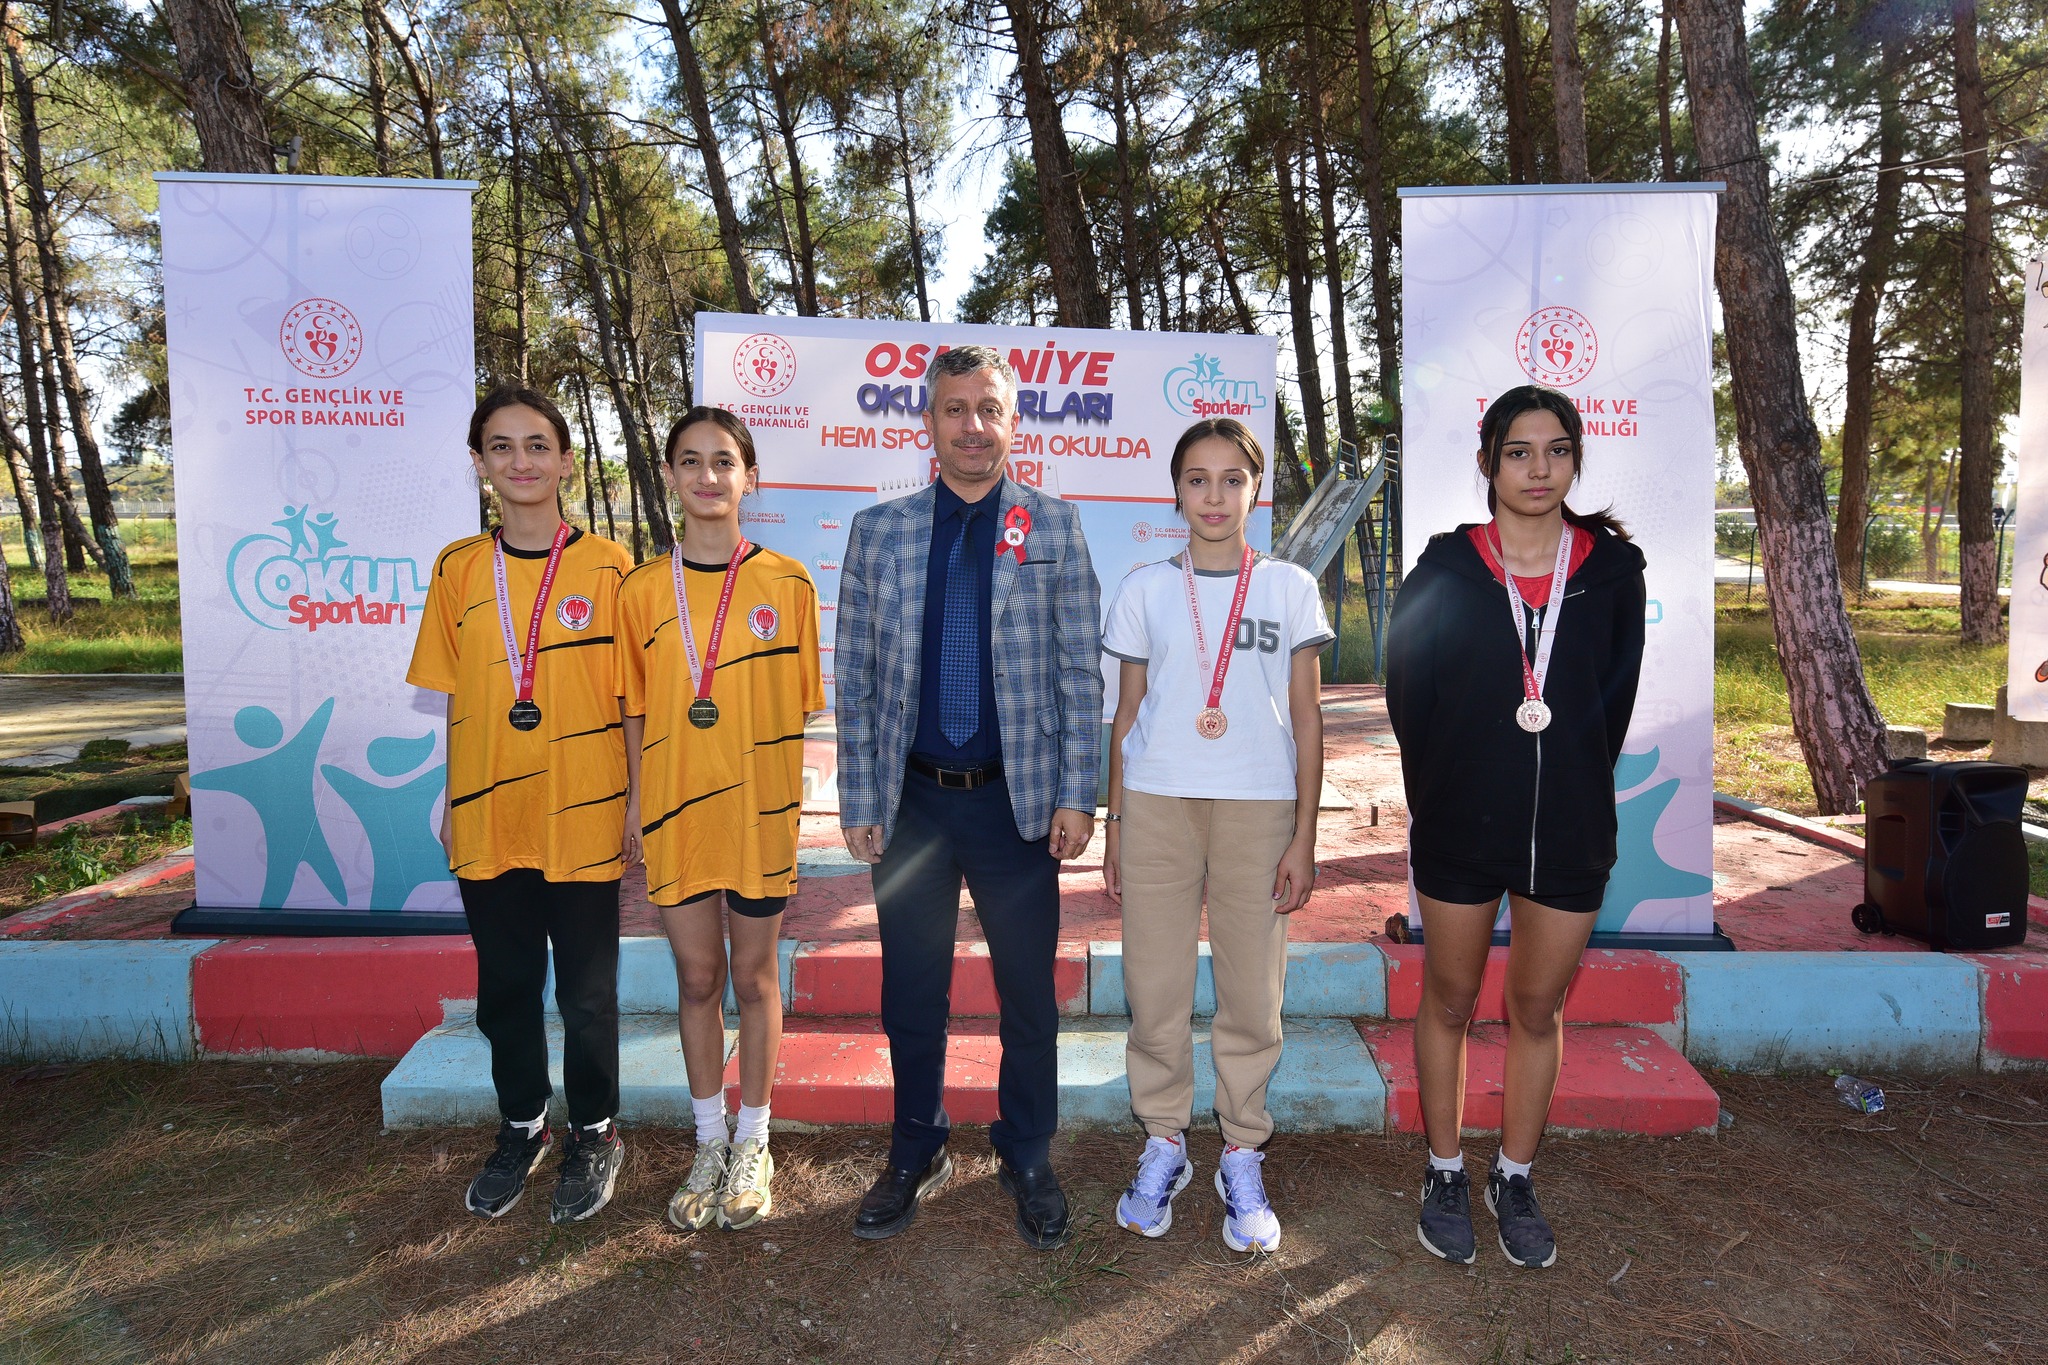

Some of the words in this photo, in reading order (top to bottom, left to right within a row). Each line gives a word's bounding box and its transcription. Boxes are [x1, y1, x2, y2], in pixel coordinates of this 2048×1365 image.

[865, 341, 1115, 386] OSNİYE
[244, 387, 279, 403] T.C.
[285, 386, 372, 408] GENÇLİK
[379, 390, 403, 405] VE
[857, 383, 928, 413] OKU
[1017, 389, 1113, 421] RLARI
[1192, 398, 1250, 418] Sporları
[1612, 399, 1637, 414] VE
[245, 409, 296, 425] SPOR
[302, 408, 404, 427] BAKANLIĞI
[741, 403, 791, 416] GENÇLİK
[795, 406, 809, 416] VE
[749, 417, 809, 429] BAKANLIĞI
[1582, 418, 1637, 437] NLIĞI
[821, 425, 876, 449] HEM
[1010, 434, 1043, 456] EM
[1049, 434, 1151, 459] OKULDA
[543, 547, 560, 585] CUMHURİYETİ
[255, 554, 430, 611] OKUL
[724, 570, 734, 594] GENÇLİK
[536, 585, 548, 610] GENÇLİK
[288, 593, 406, 633] Sporları
[533, 611, 540, 619] VE
[717, 603, 726, 618] SPOR
[1217, 658, 1227, 682] TÜRKİYE
[1223, 616, 1237, 657] CUMHURİYETİ
[1234, 593, 1243, 616] GENÇLİK
[1233, 617, 1281, 655] 05
[526, 638, 536, 670] BAKANLIĞI
[1525, 676, 1534, 694] SPOR
